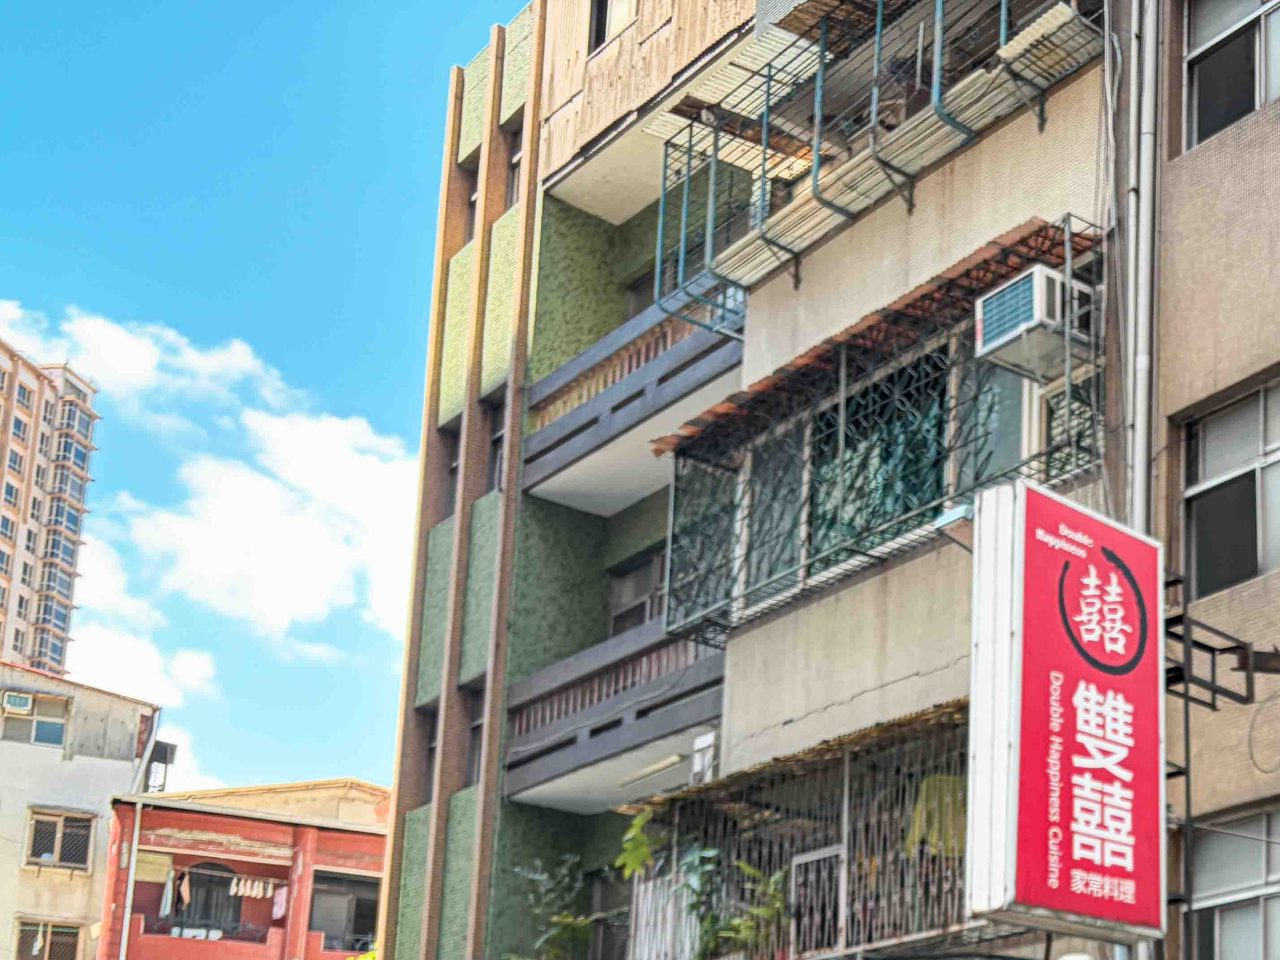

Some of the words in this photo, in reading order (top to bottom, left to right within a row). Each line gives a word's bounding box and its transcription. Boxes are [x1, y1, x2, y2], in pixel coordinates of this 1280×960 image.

[1049, 671, 1064, 733] Double
[1046, 736, 1063, 823] Happiness
[1070, 680, 1135, 872] 雙囍
[1048, 826, 1062, 889] Cuisine
[1070, 868, 1136, 904] 家常料理
